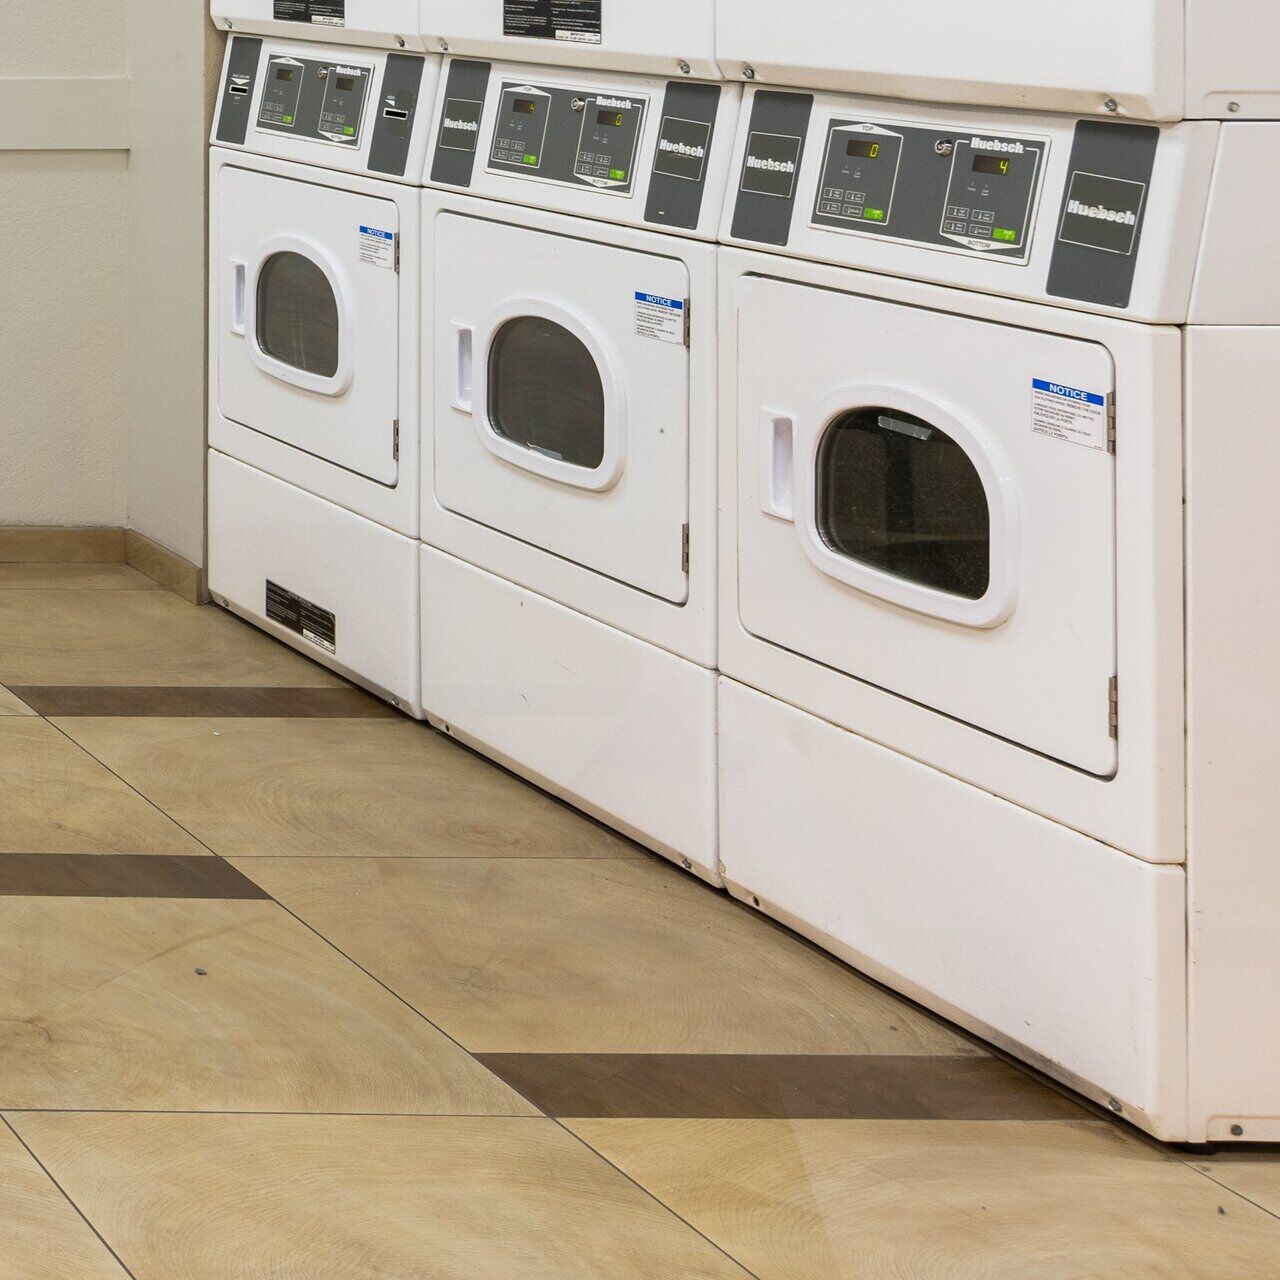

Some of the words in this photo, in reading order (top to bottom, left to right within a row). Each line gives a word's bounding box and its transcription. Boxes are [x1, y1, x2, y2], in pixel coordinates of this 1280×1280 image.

[595, 96, 632, 110] Huebsch
[443, 118, 478, 131] Huebsch
[615, 114, 623, 126] 0
[659, 138, 704, 158] Huebsch
[870, 144, 879, 157] 0
[970, 137, 1024, 154] Huebsch
[746, 155, 795, 173] Huebsch
[1000, 160, 1008, 174] 4
[1067, 200, 1135, 225] Huebsch
[367, 228, 385, 238] NOTICE
[967, 239, 991, 248] BOTTOM
[646, 295, 672, 307] NOTICE
[1049, 383, 1088, 401] NOTICE
